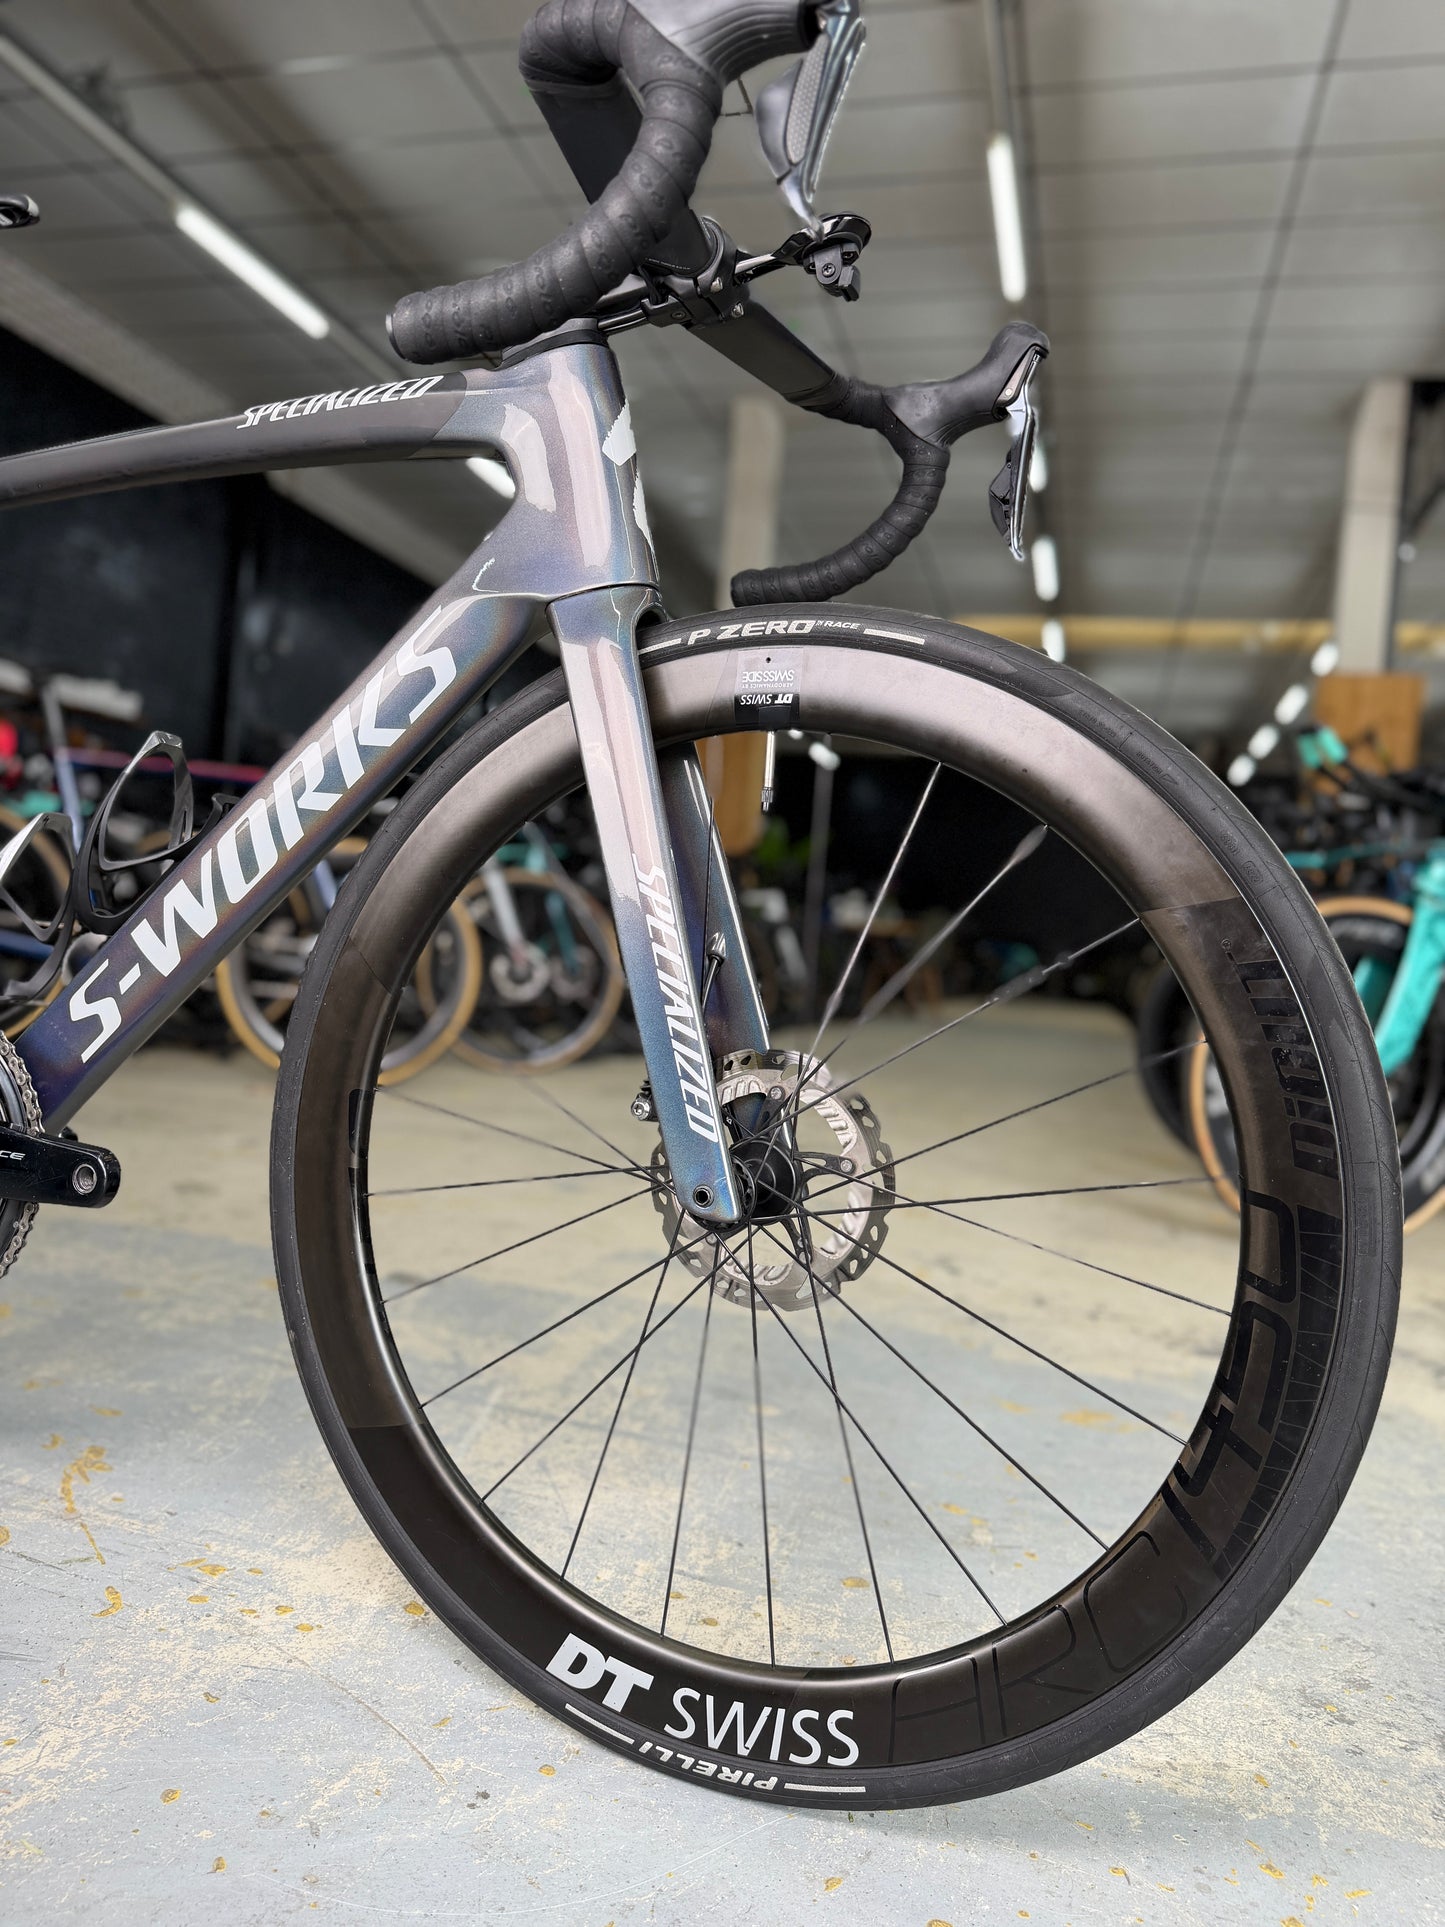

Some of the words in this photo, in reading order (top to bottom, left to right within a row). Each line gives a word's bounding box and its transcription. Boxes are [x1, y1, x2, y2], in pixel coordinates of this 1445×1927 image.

[236, 375, 444, 429] SPECIALIZED
[687, 628, 711, 645] P
[716, 619, 816, 640] ZERO
[823, 620, 861, 630] RACE
[740, 693, 773, 705] SWISS
[774, 693, 794, 704] DT
[69, 604, 457, 1064] S-WORKS
[632, 852, 719, 1143] SPECIALIZED
[545, 1632, 654, 1713] DT
[663, 1687, 860, 1767] SWISS
[639, 1741, 779, 1791] PIRELLI
